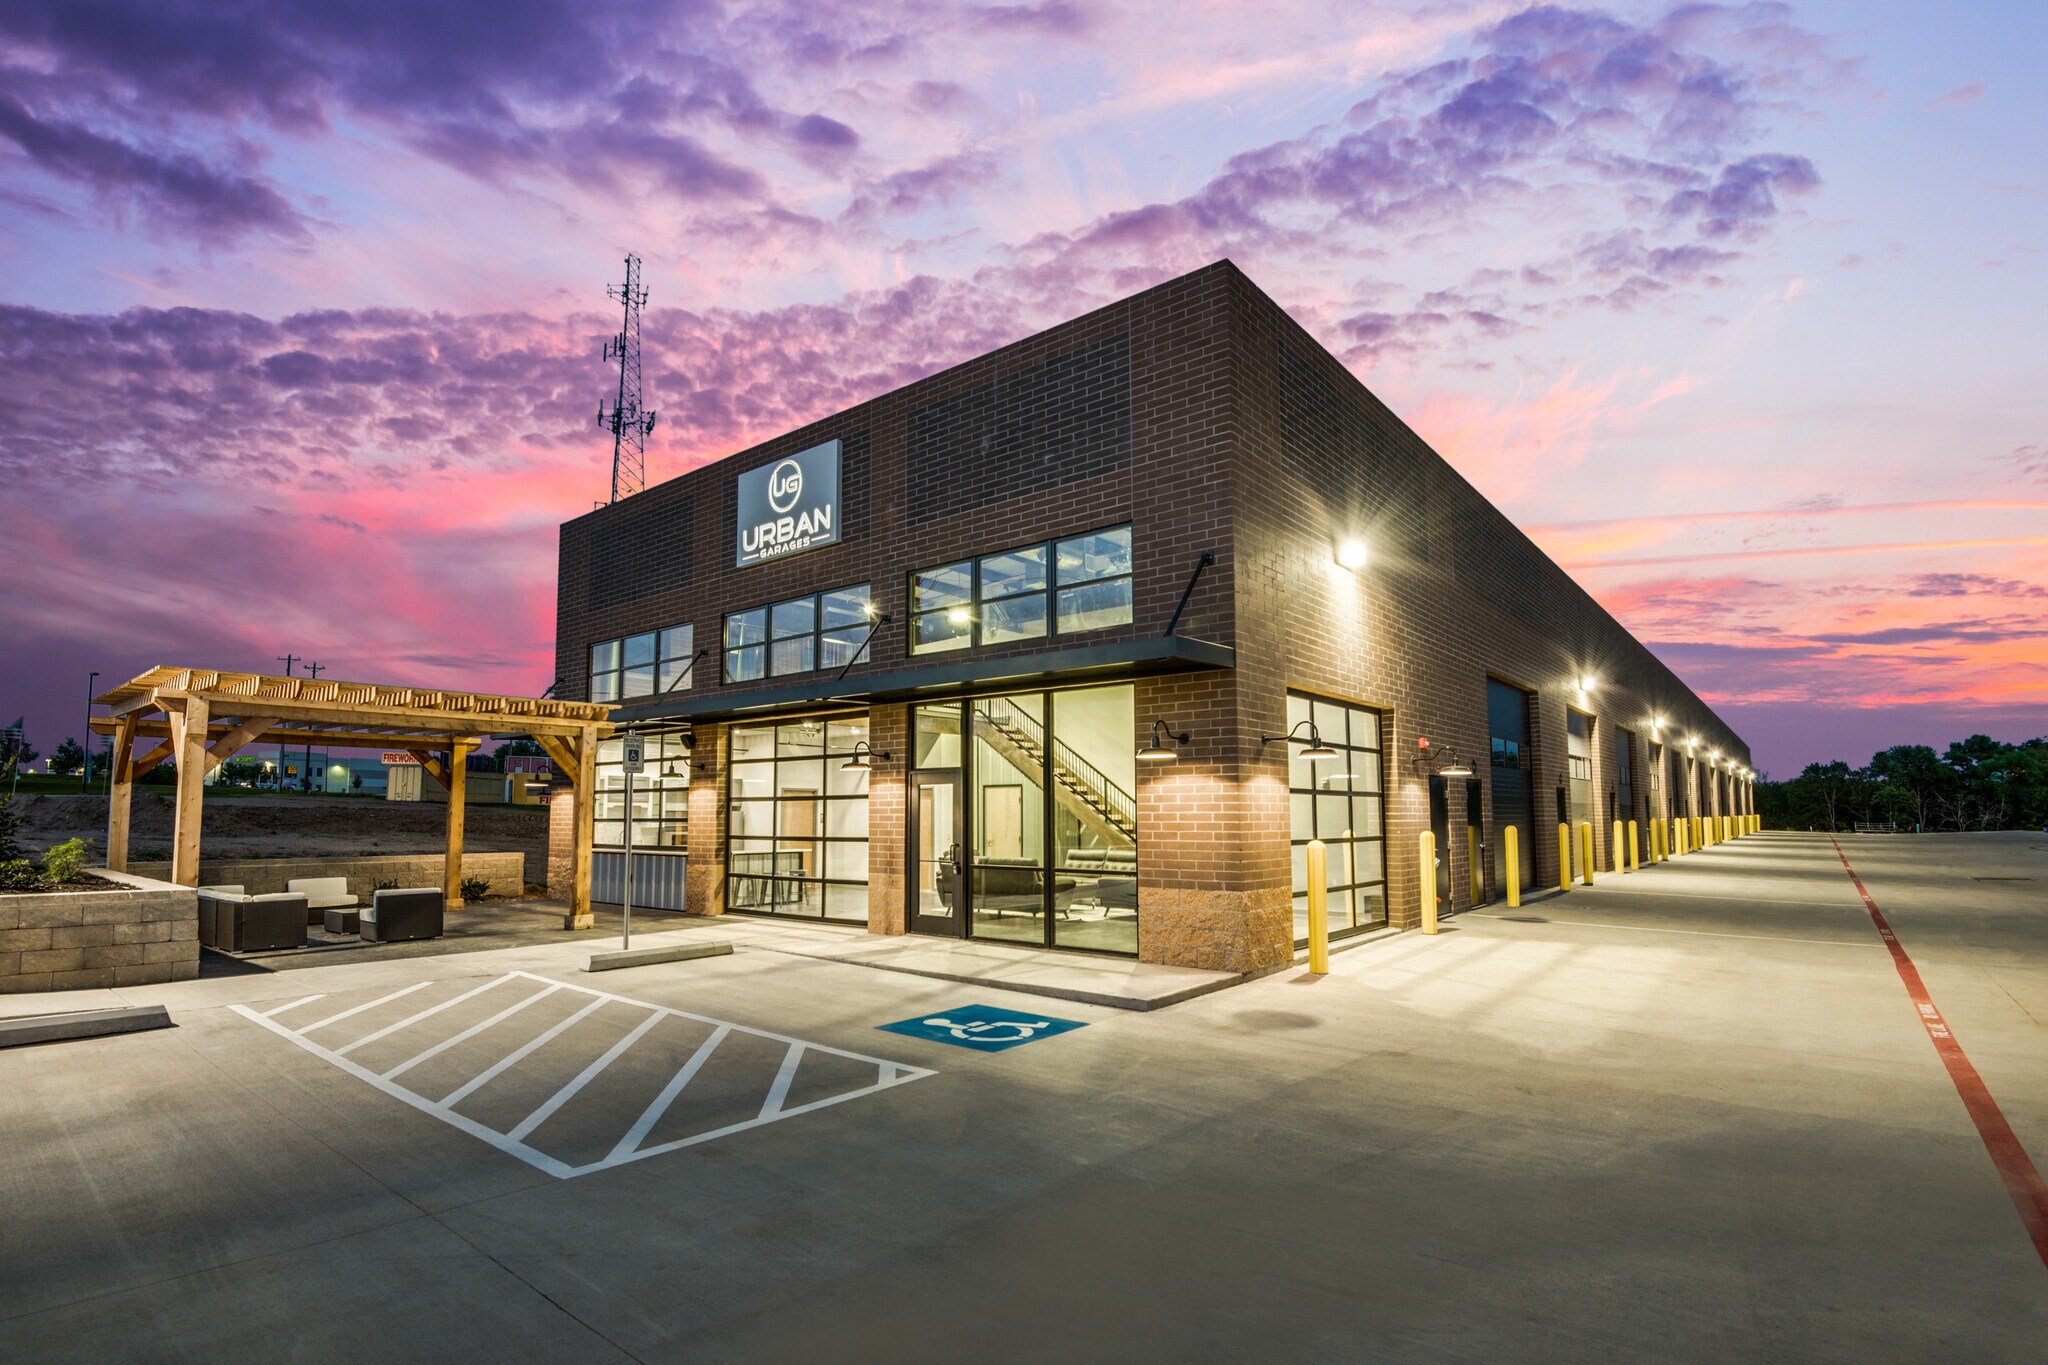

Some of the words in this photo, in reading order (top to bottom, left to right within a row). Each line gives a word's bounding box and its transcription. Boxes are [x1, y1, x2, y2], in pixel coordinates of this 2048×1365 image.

[772, 470, 802, 498] UG
[742, 503, 831, 552] URBAN
[759, 536, 810, 558] GARAGES
[383, 753, 420, 763] FIREWOR
[539, 796, 551, 804] FI
